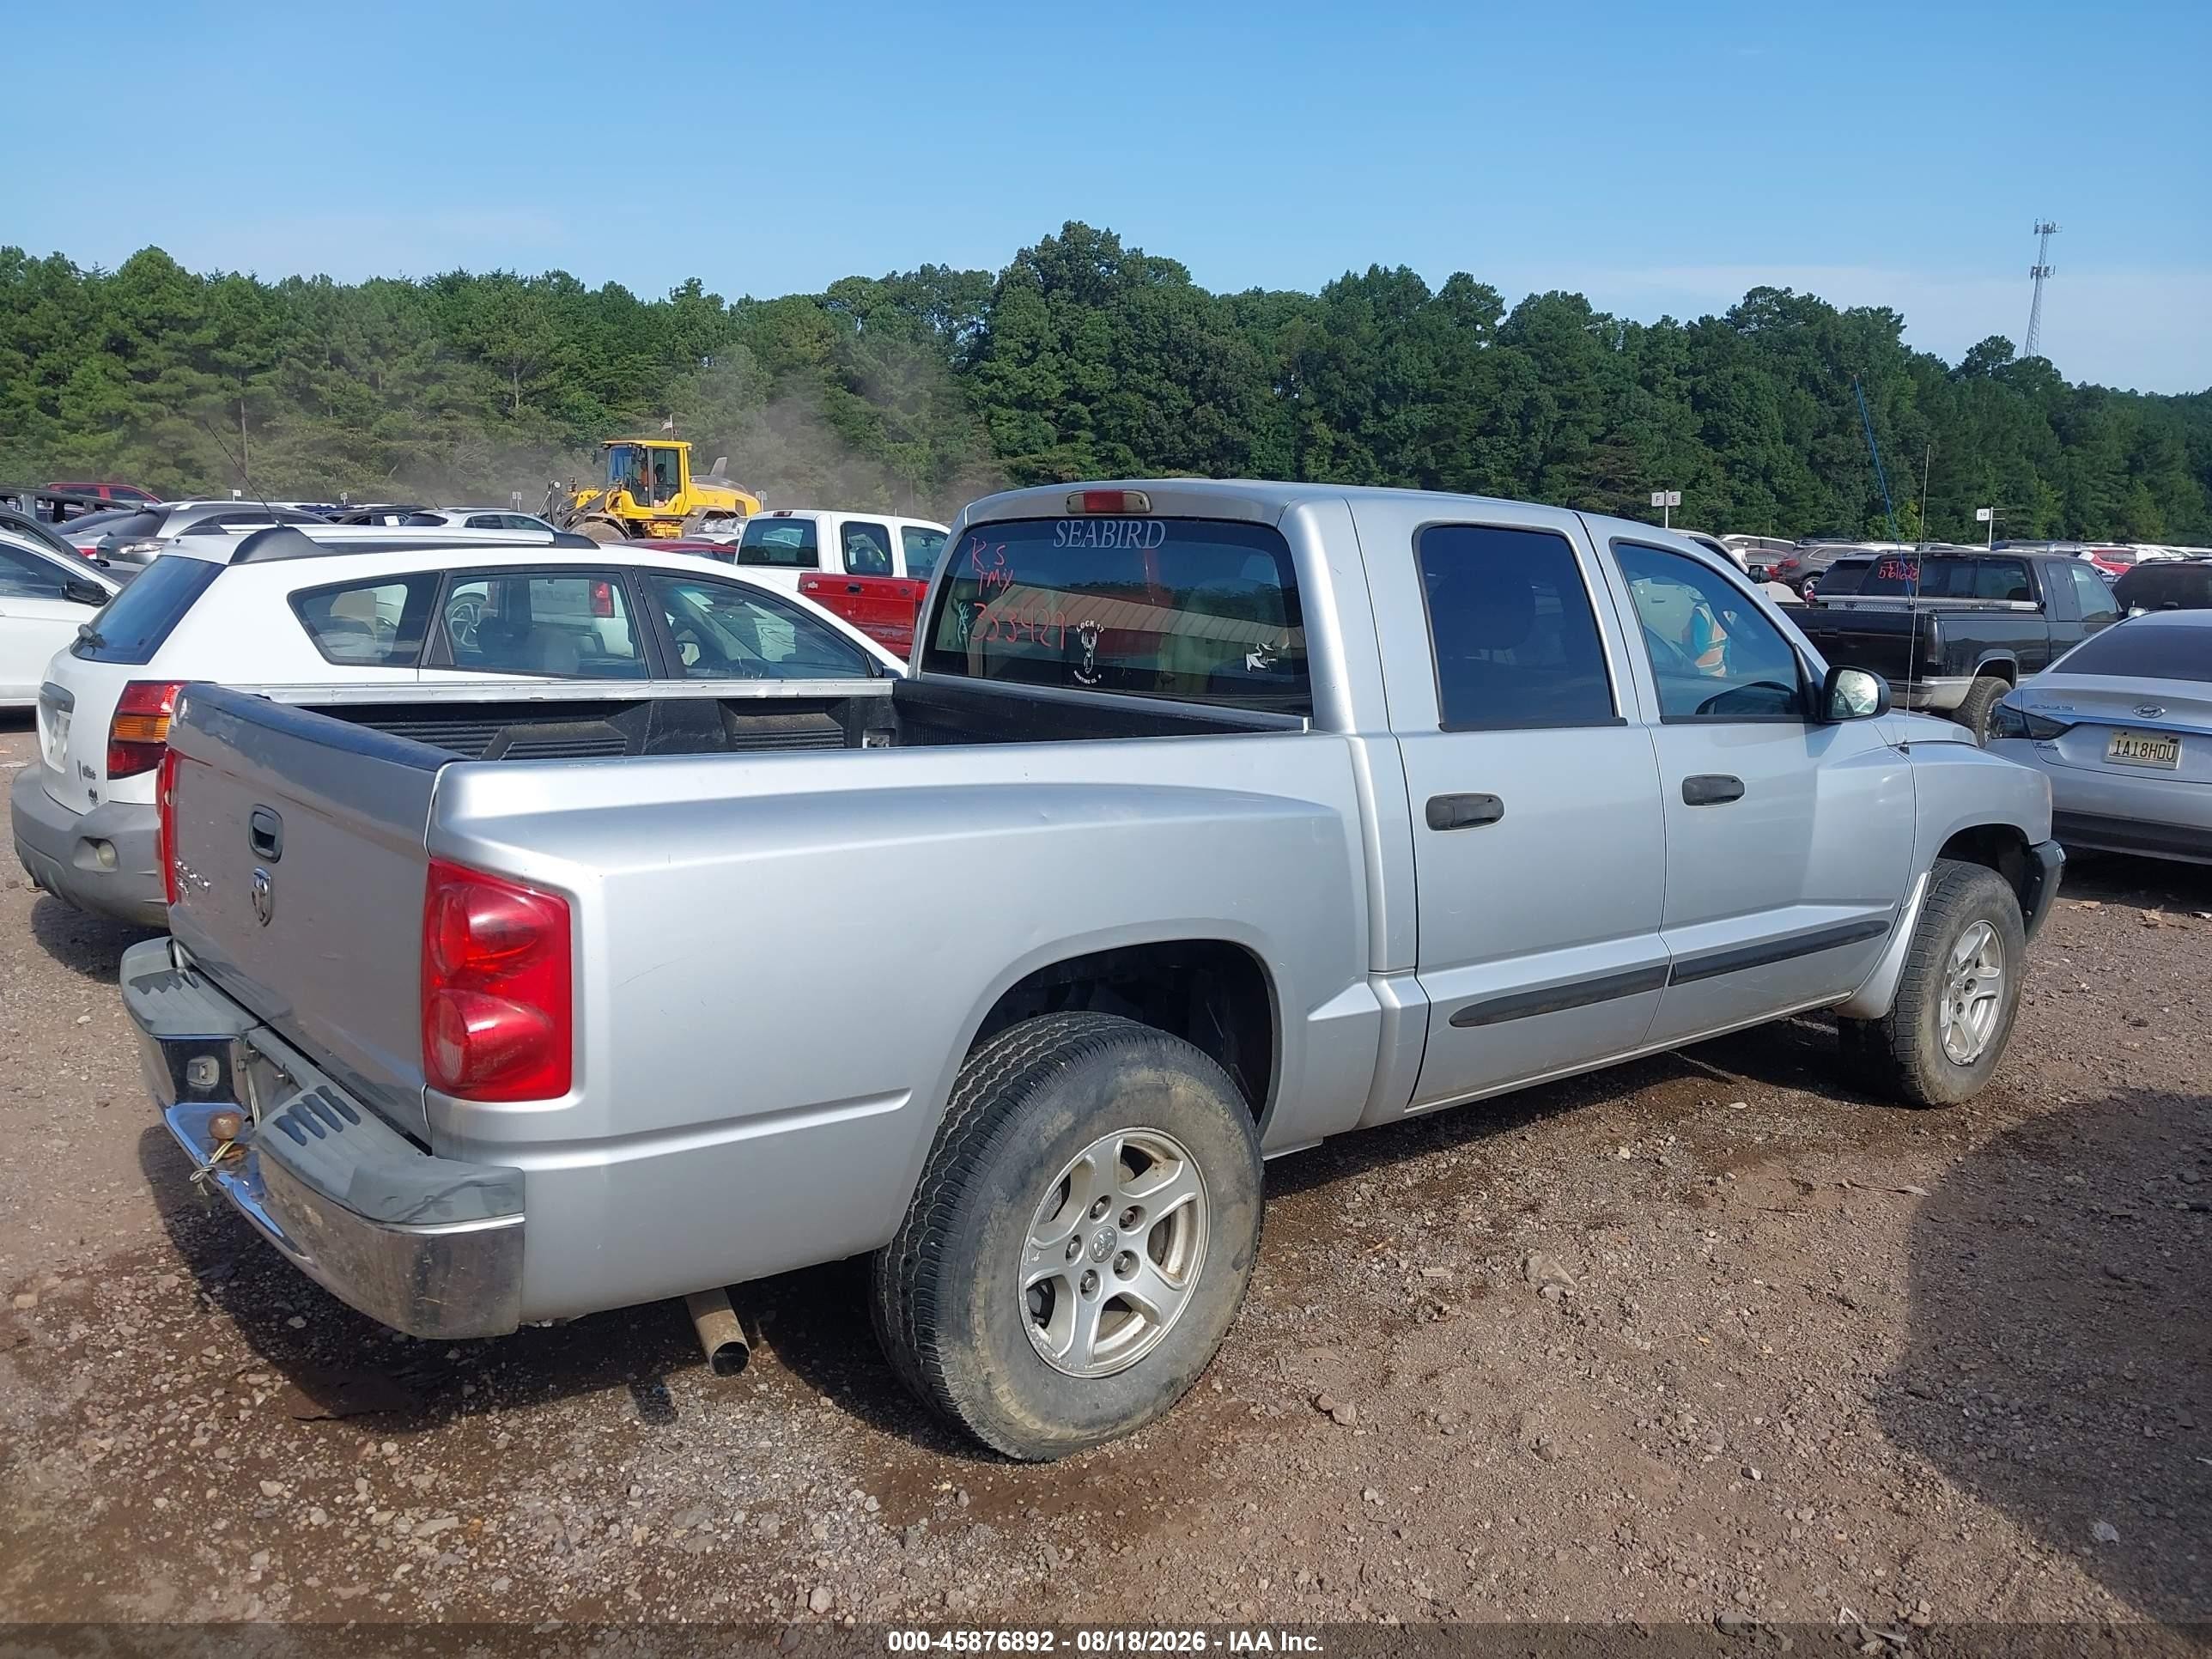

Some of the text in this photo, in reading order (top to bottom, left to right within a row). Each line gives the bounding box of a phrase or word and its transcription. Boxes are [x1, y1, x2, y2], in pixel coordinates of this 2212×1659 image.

[1053, 520, 1166, 550] SEABIRD
[1076, 620, 1096, 635] LOCK
[2112, 739, 2177, 761] 1A18HDU
